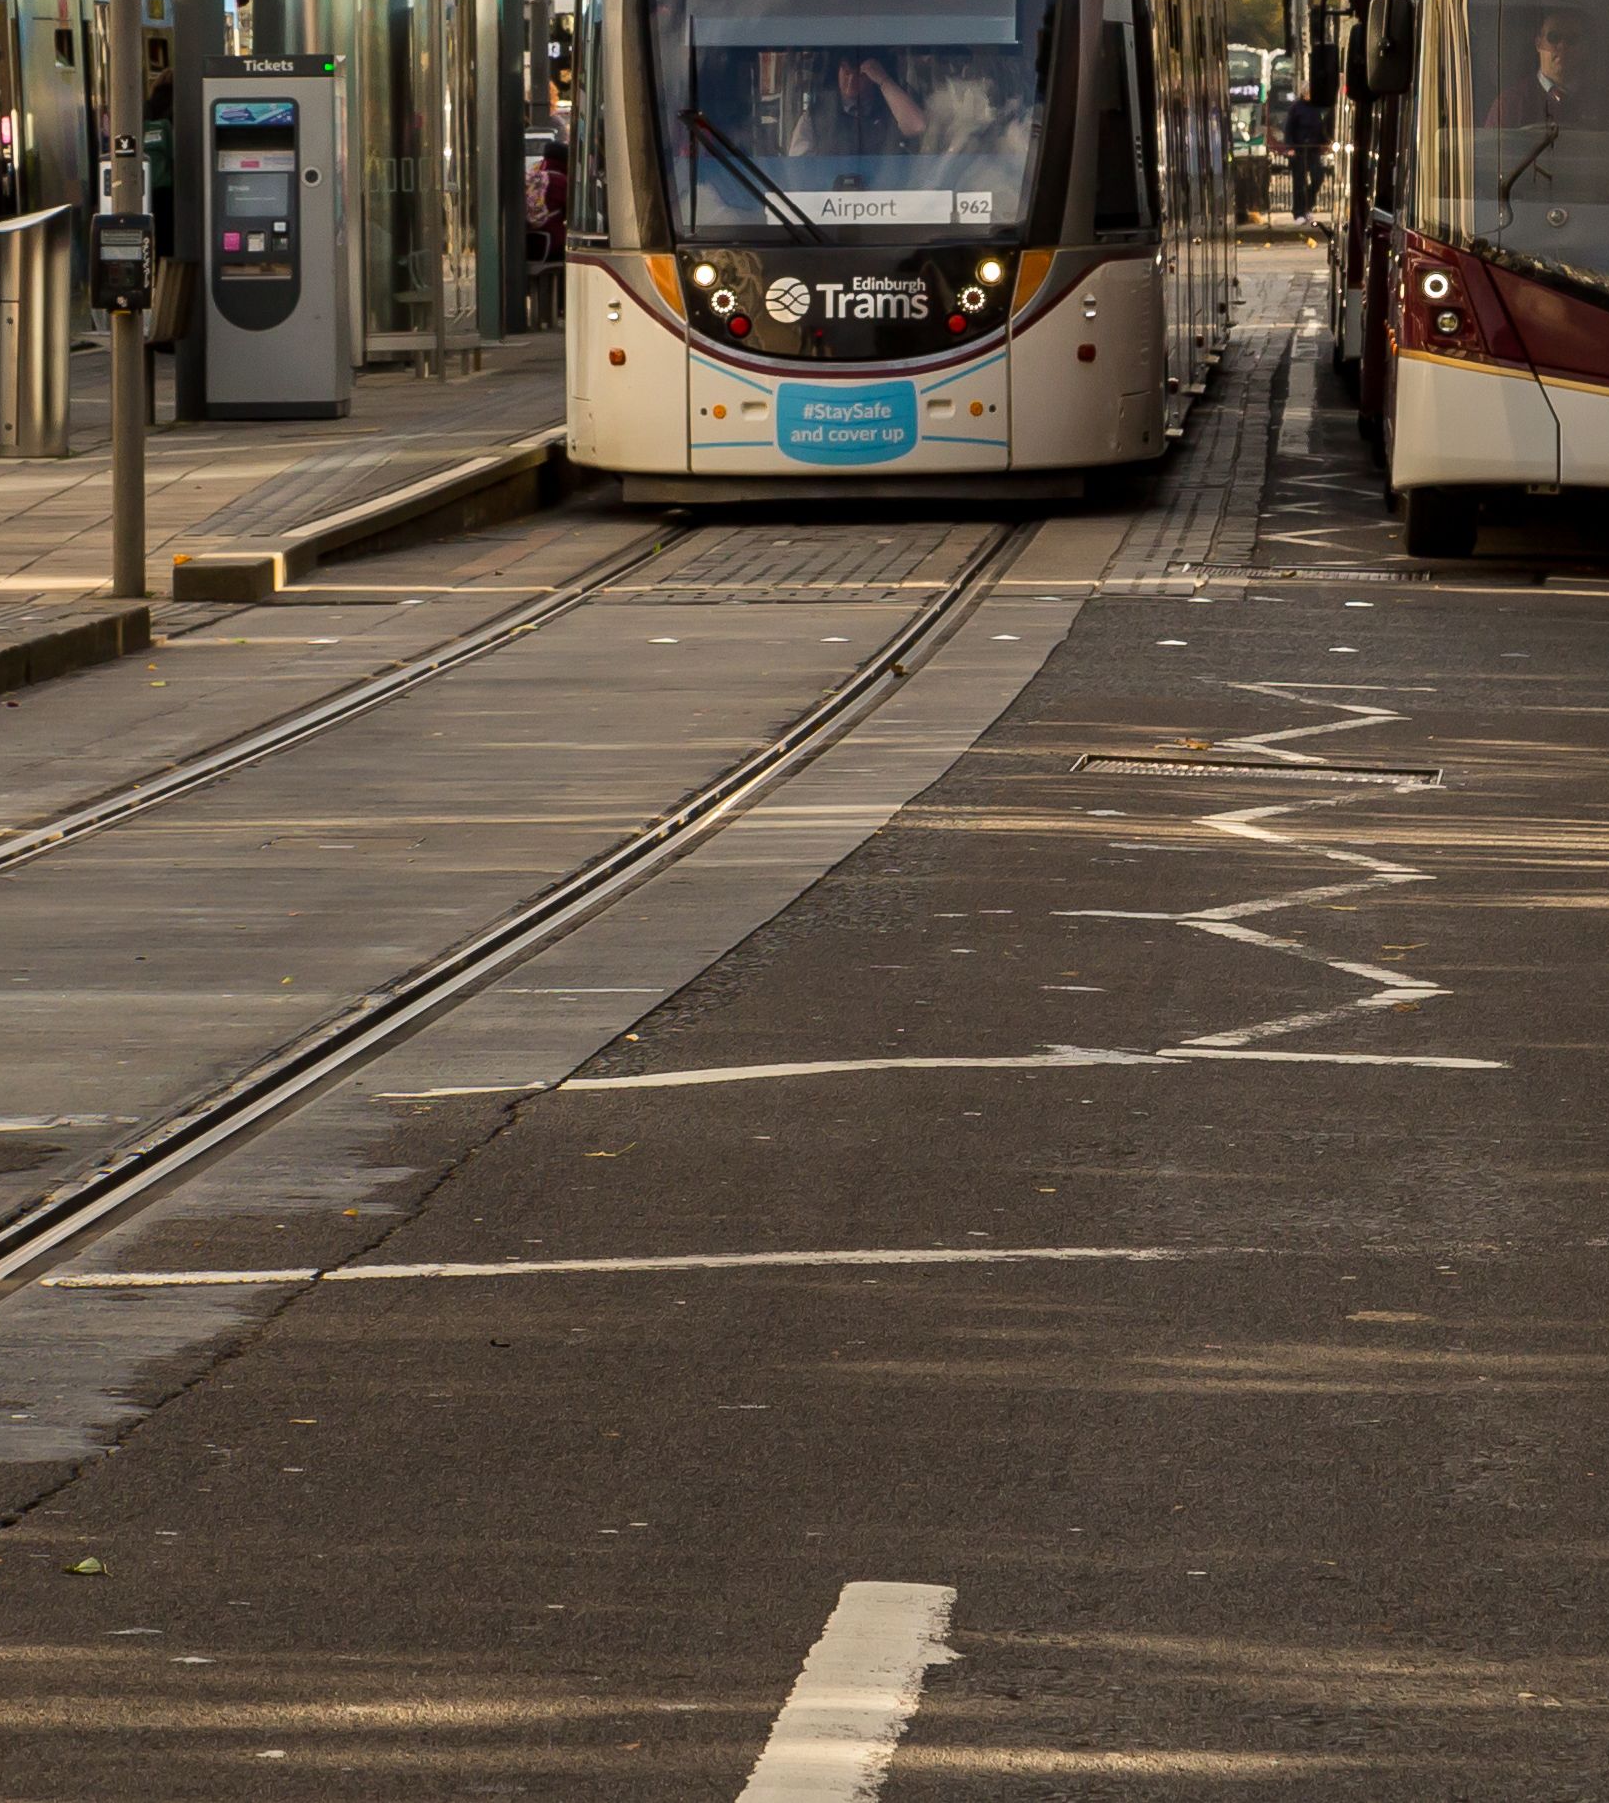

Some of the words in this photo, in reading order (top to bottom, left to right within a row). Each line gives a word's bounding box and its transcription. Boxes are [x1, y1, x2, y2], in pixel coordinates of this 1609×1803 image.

[243, 59, 294, 72] Tickets
[821, 198, 897, 220] Airport
[959, 199, 991, 215] 962
[852, 276, 926, 293] Edinburgh
[816, 283, 929, 320] Trams
[803, 402, 891, 422] #StaySafe
[791, 426, 823, 442] and
[828, 428, 878, 442] cover
[882, 428, 904, 443] up
